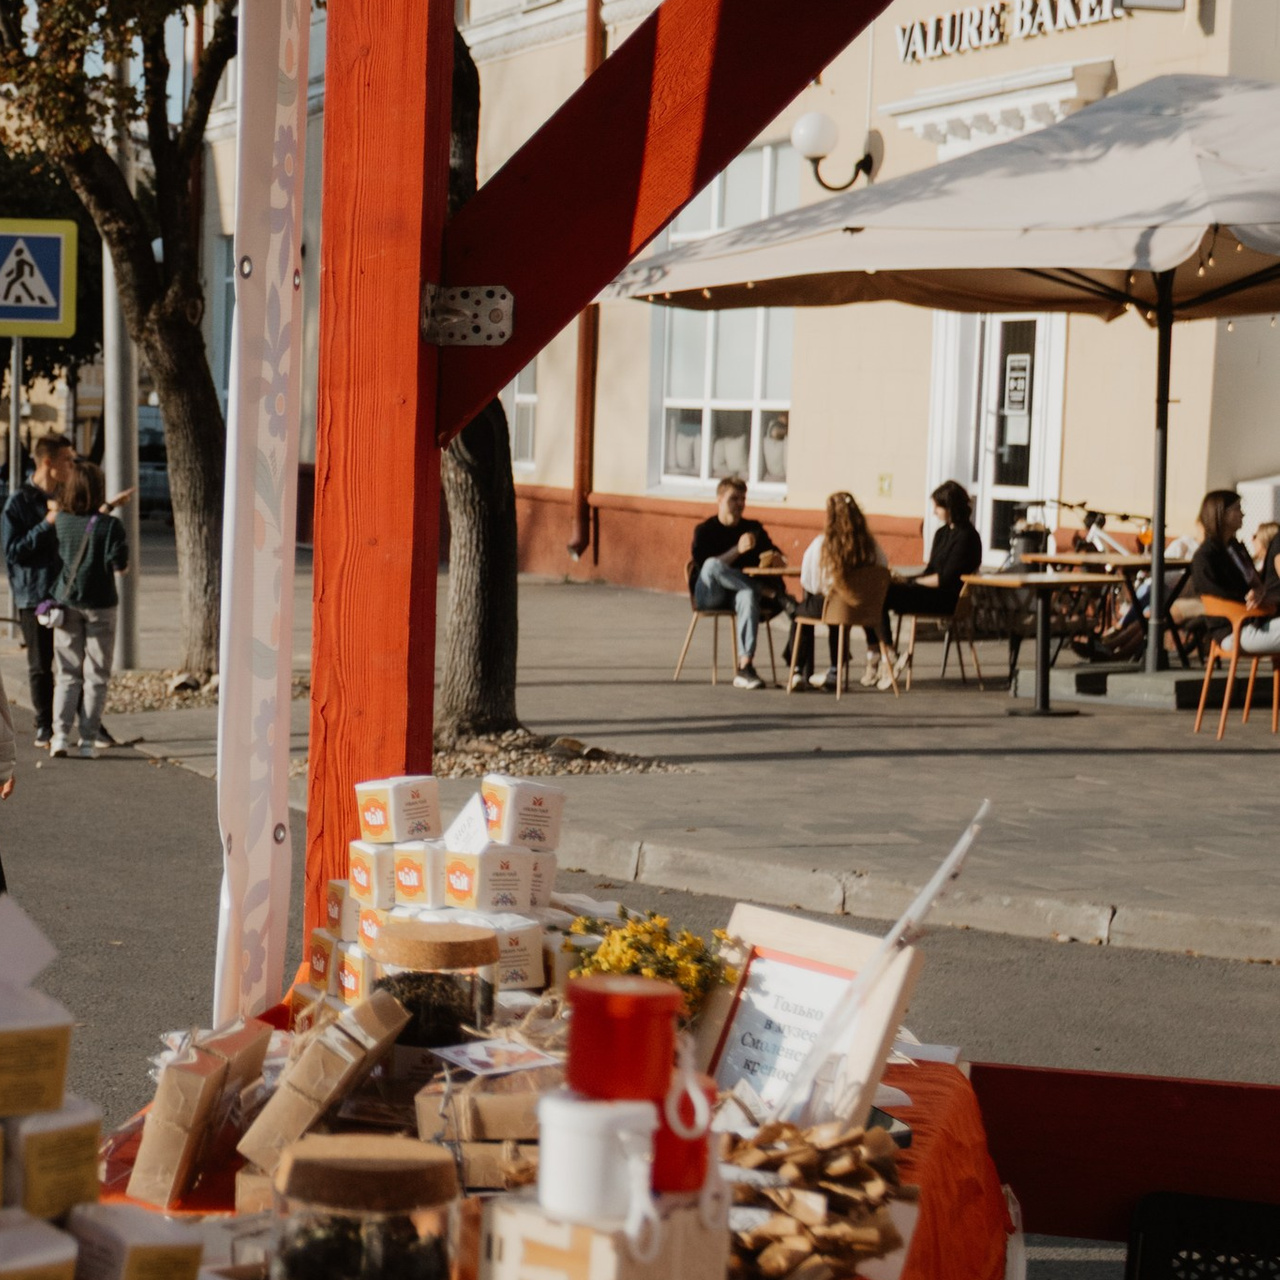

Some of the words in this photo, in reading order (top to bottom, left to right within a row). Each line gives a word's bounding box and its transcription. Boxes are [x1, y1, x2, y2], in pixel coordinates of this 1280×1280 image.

[895, 0, 1002, 63] VALURE
[773, 994, 824, 1020] Только
[764, 1018, 772, 1031] в
[773, 1022, 818, 1042] музее
[741, 1031, 807, 1063] Смоленс
[743, 1058, 795, 1082] крепос
